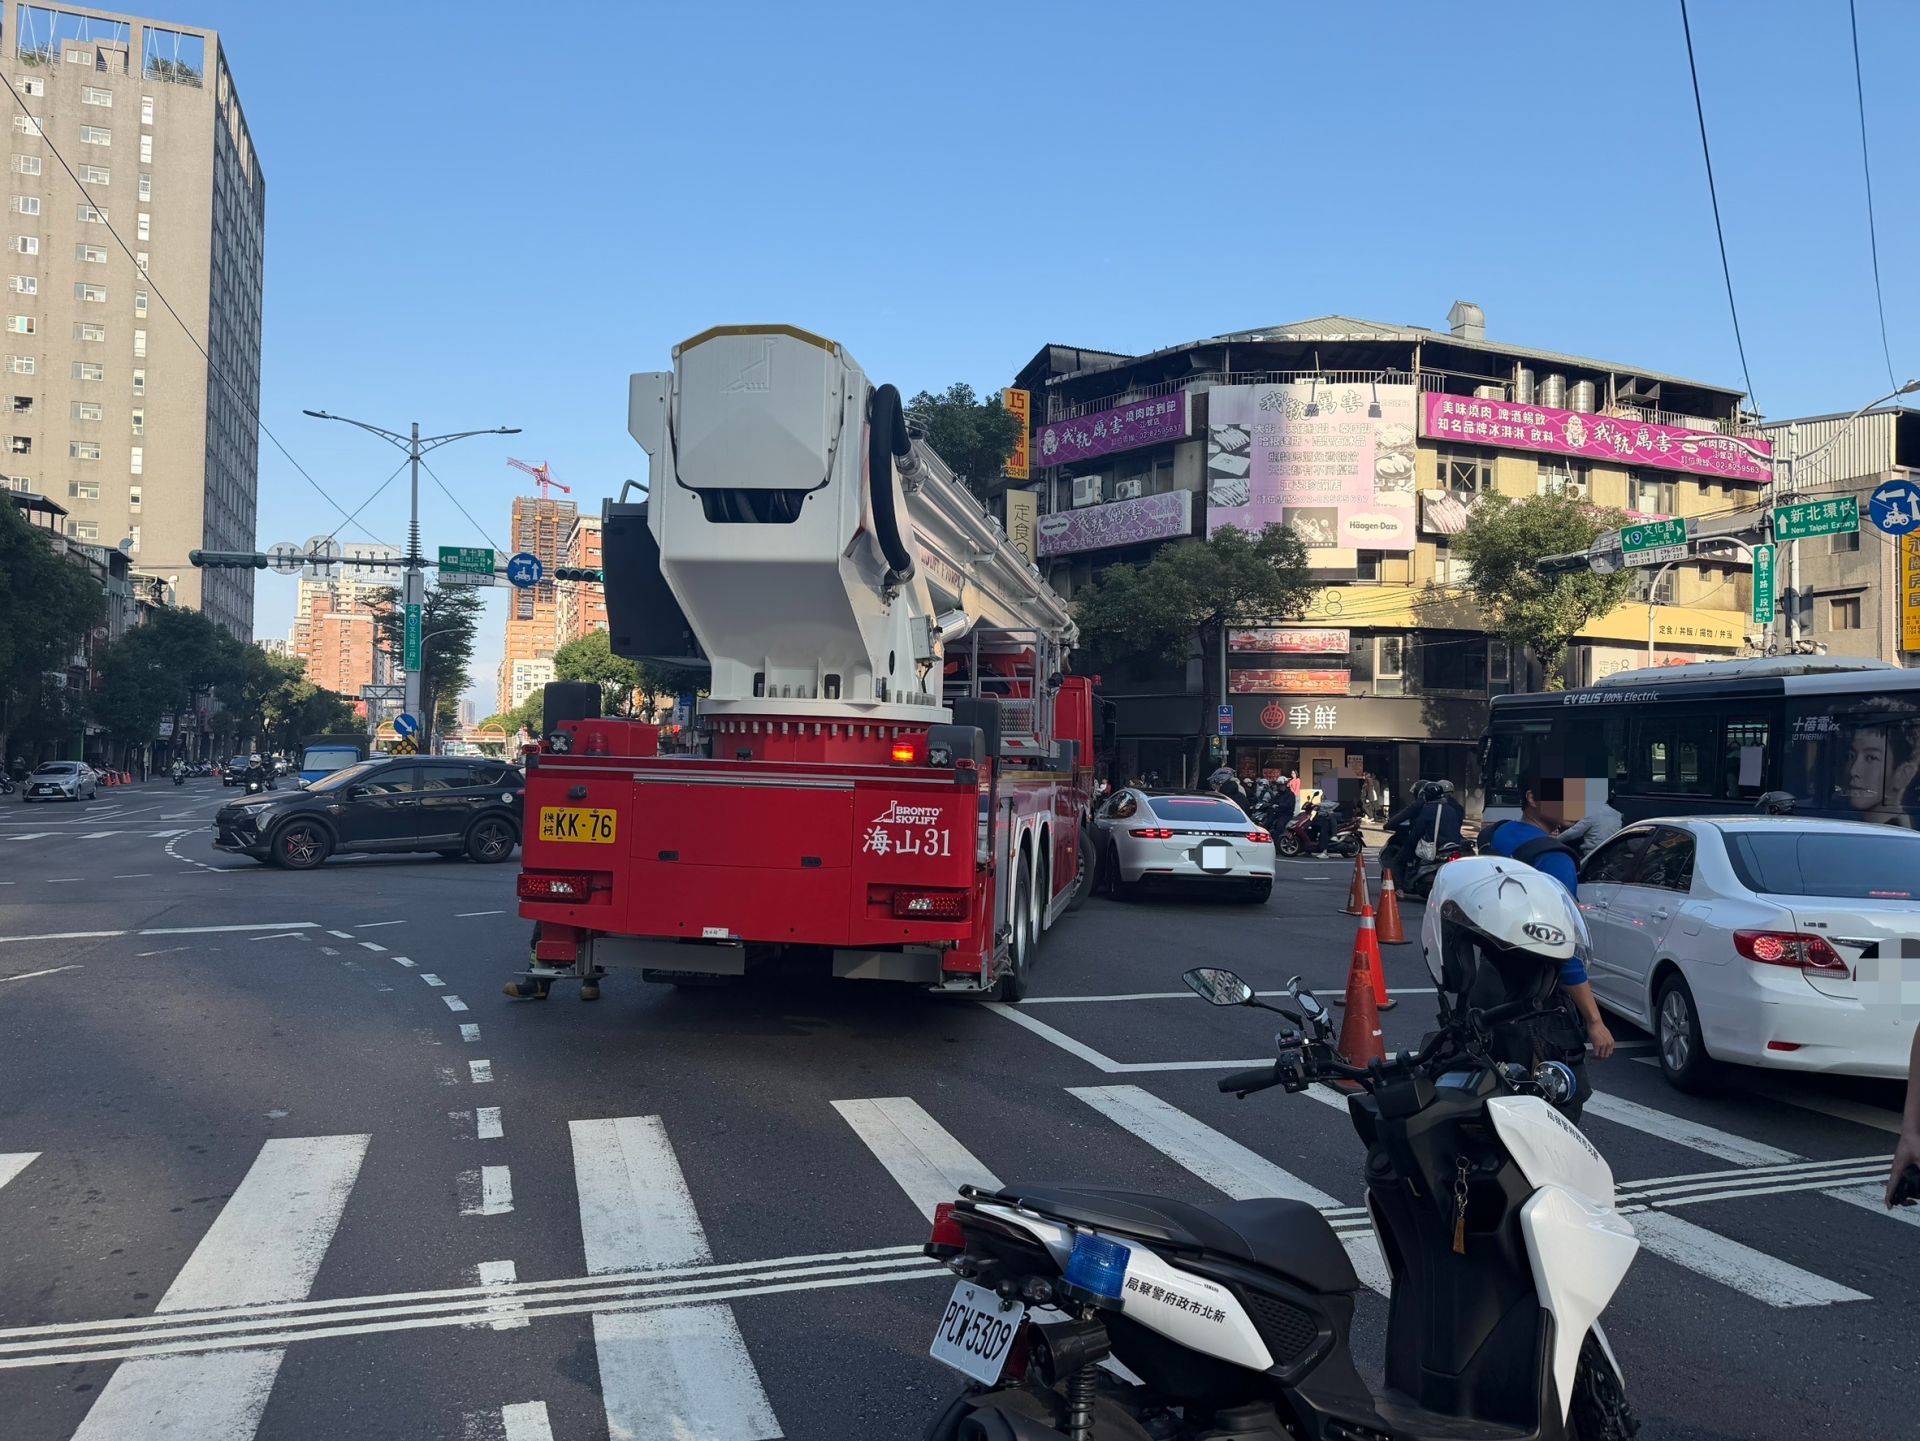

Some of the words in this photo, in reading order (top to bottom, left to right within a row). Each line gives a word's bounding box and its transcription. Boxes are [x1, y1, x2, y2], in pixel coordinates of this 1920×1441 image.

[1442, 401, 1492, 419] 美味燒肉
[1498, 408, 1546, 426] 啤酒暢飲
[1438, 418, 1525, 440] 知名品牌冰淇淋
[1531, 429, 1554, 443] 飲料
[1790, 502, 1855, 524] 新北環快
[1634, 533, 1640, 541] 3
[1643, 521, 1674, 536] 文化路
[1809, 522, 1829, 533] Taipei
[1659, 625, 1673, 635] 定食
[1579, 692, 1603, 704] BUS
[1603, 692, 1623, 703] 100%
[1624, 690, 1660, 702] Electric
[1289, 704, 1337, 730] 爭鮮
[556, 813, 613, 838] KK-76
[895, 815, 937, 826] SKYLIFT
[862, 825, 951, 857] 海山31
[938, 1300, 1012, 1362] PCW-5309
